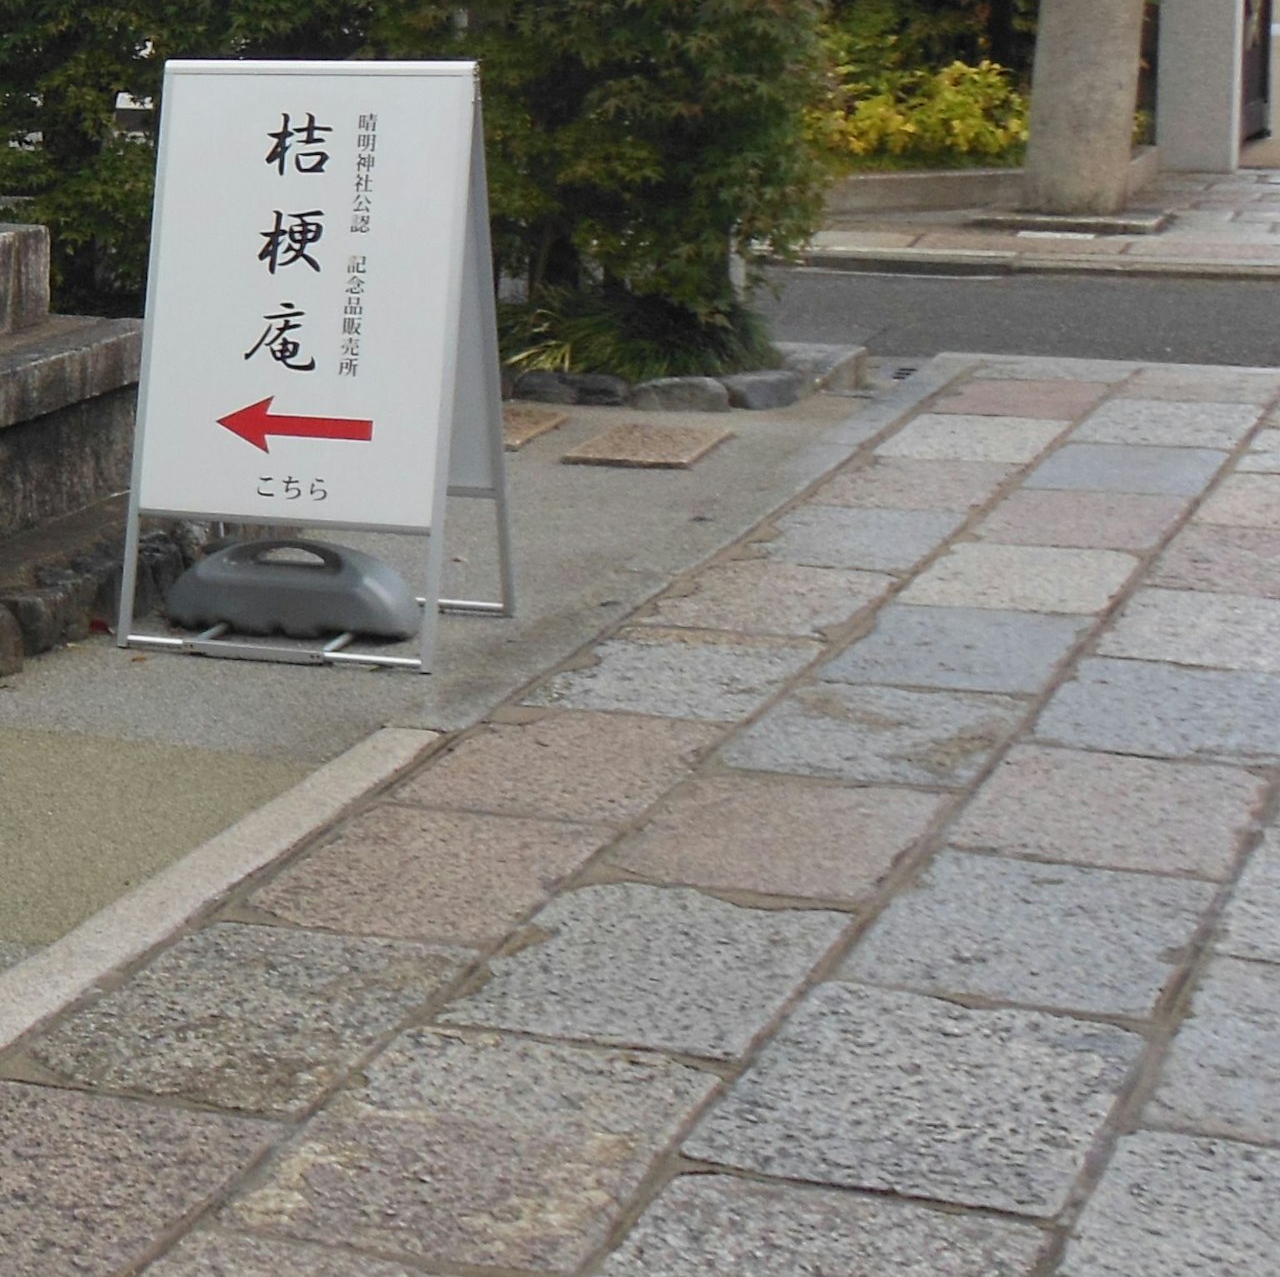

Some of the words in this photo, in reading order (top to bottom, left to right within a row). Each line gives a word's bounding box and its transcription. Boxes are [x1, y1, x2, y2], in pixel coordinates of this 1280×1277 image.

[349, 112, 378, 234] 晴明神社公認
[244, 111, 333, 372] 桔梗庵
[337, 254, 368, 378] 記念品販売所
[256, 474, 329, 502] こちら
